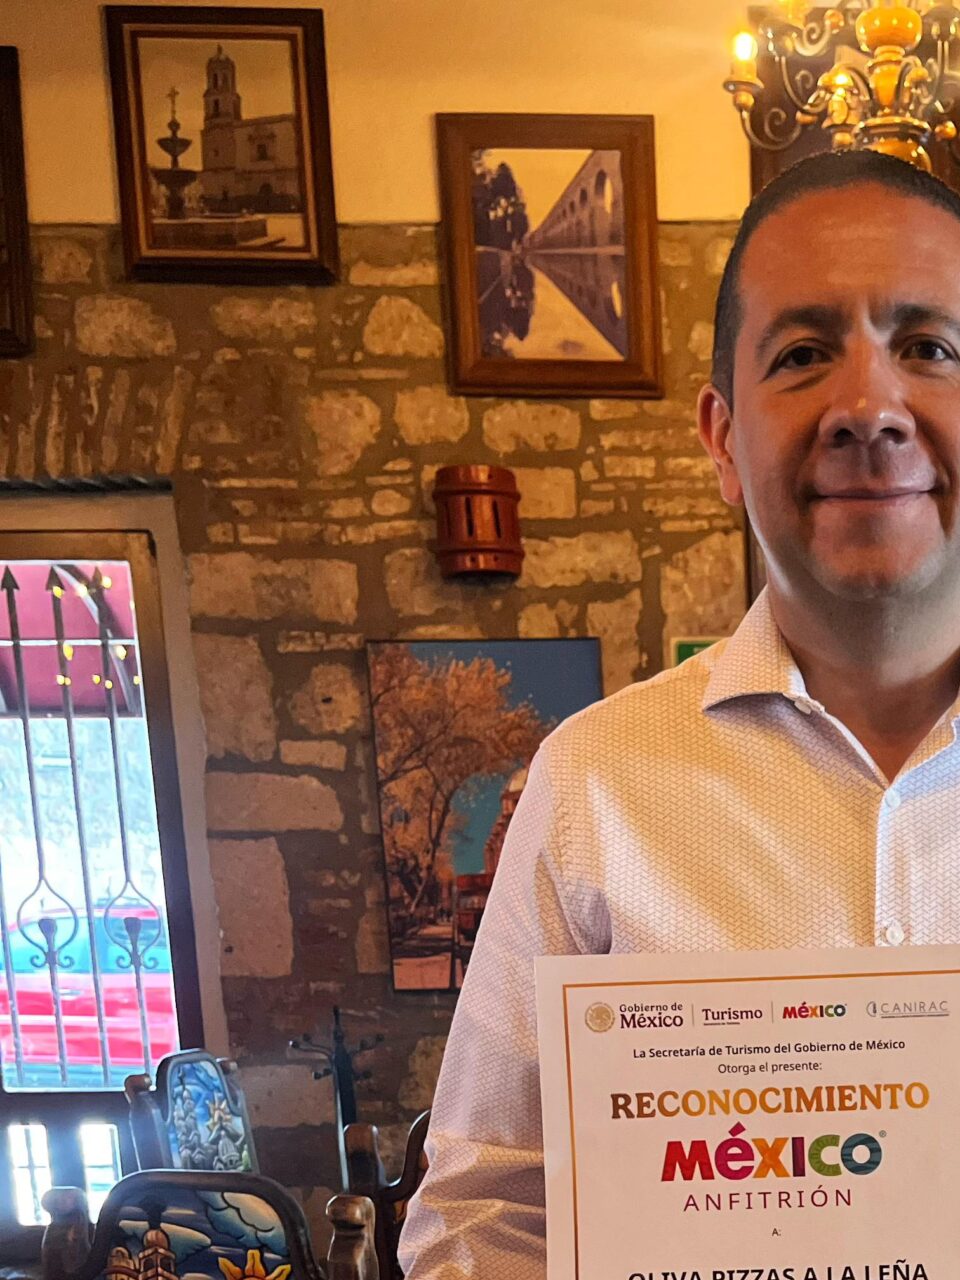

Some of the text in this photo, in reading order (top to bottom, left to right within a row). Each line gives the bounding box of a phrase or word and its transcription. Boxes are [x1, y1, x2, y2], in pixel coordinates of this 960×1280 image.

[619, 1002, 683, 1013] Gobierno de
[881, 1001, 948, 1013] CANIRAC
[620, 1012, 683, 1029] México
[702, 1008, 763, 1020] Turismo
[633, 1040, 905, 1058] La Secretaría de Turismo del Gobierno de México
[718, 1062, 822, 1075] Otorga el presente:
[610, 1082, 930, 1119] RECONOCIMIENTO
[683, 1186, 852, 1212] ANFITRIÓN
[772, 1228, 781, 1237] A:
